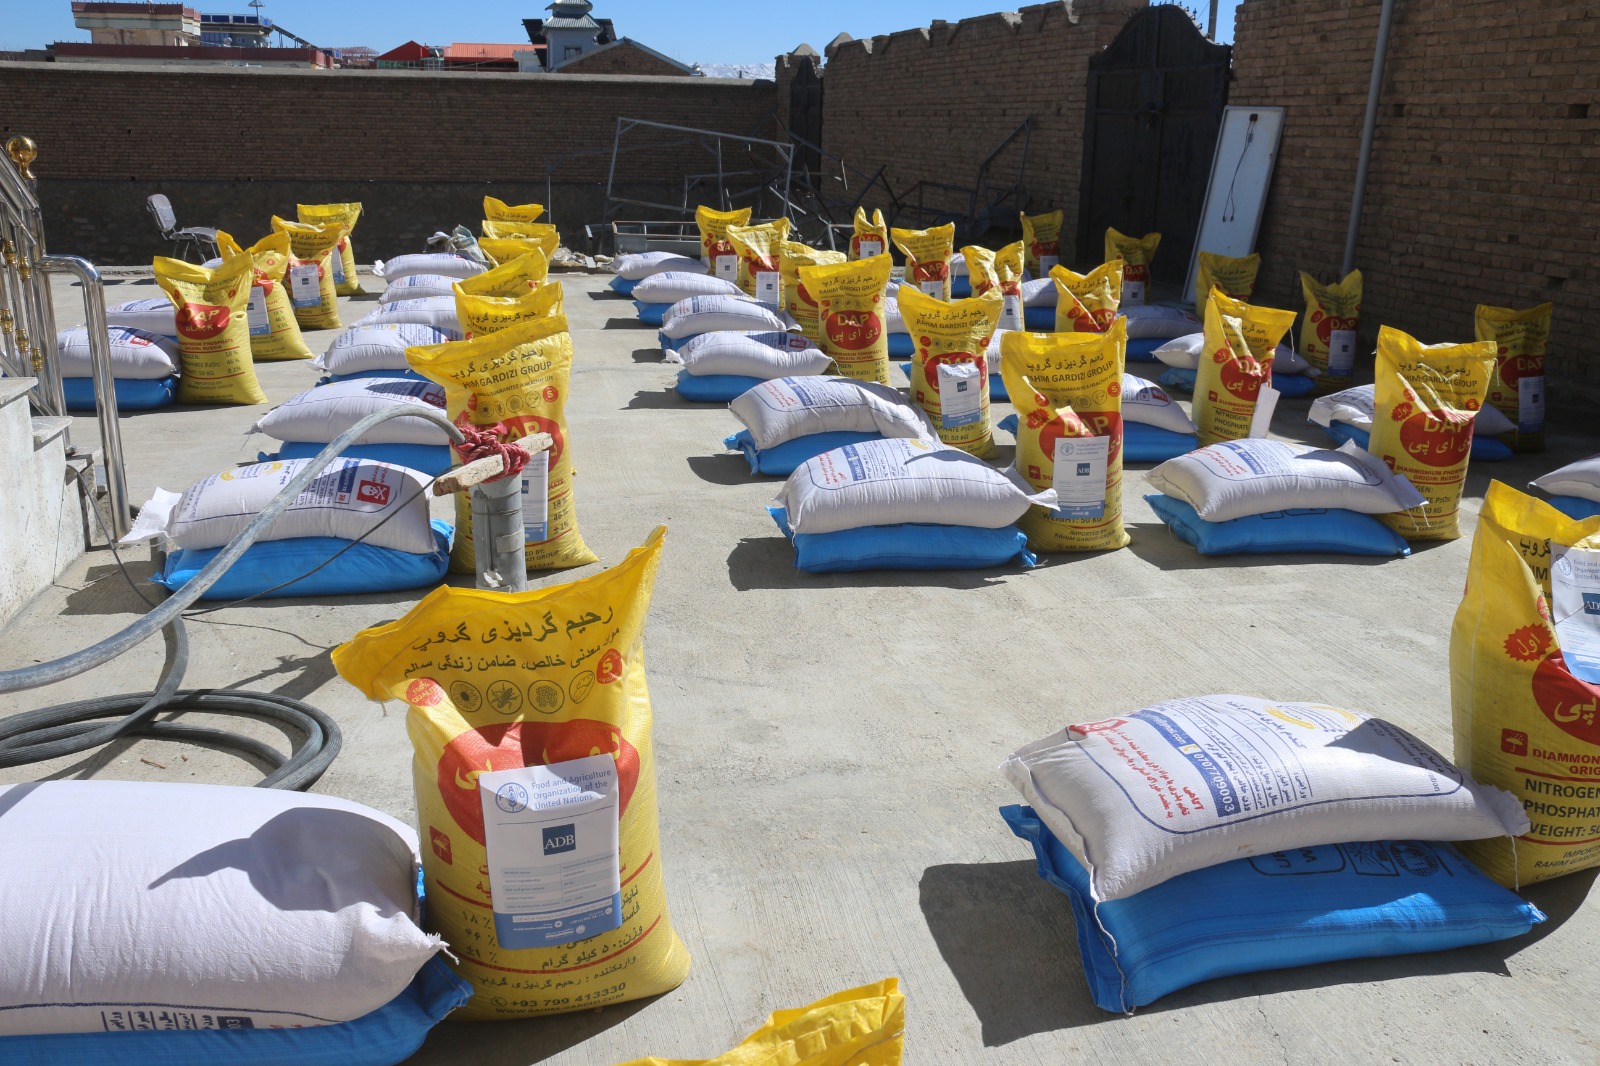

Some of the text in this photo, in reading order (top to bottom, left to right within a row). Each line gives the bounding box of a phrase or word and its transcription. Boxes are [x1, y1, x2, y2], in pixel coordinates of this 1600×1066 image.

[479, 352, 517, 373] گردیزی
[1026, 358, 1051, 372] گروپ
[480, 361, 552, 386] GARDIZI GROUP
[1026, 360, 1113, 382] AHIM GARDIZI GROUP
[1216, 410, 1248, 421] NITROGEN:
[934, 423, 960, 433] SPHATE
[1064, 415, 1108, 437] DAP
[1214, 426, 1240, 437] WEIGHT:
[1215, 418, 1249, 430] PHOSPHATE
[1424, 417, 1468, 432] DAP
[1396, 466, 1441, 475] DIAMMONIUM
[553, 501, 562, 510] 18
[554, 513, 562, 521] 46
[412, 606, 613, 652] رحیم گردیزی گروپ
[1517, 633, 1540, 656] اول
[438, 655, 472, 672] زندگی
[478, 655, 516, 671] ضامن
[570, 645, 601, 668] معدنی
[404, 660, 432, 678] سالم
[532, 768, 612, 790] Food and Agriculture
[1194, 753, 1235, 812] 0707709003
[533, 780, 608, 800] Organization of the
[535, 794, 592, 810] United Nations
[544, 833, 575, 850] ADB
[1534, 859, 1568, 868] RAHIM
[541, 954, 568, 970] گرام
[574, 949, 596, 965] کیلو
[512, 979, 552, 990] گردیزی
[555, 978, 582, 990] رحیم
[510, 982, 626, 1008] +93 799 413330
